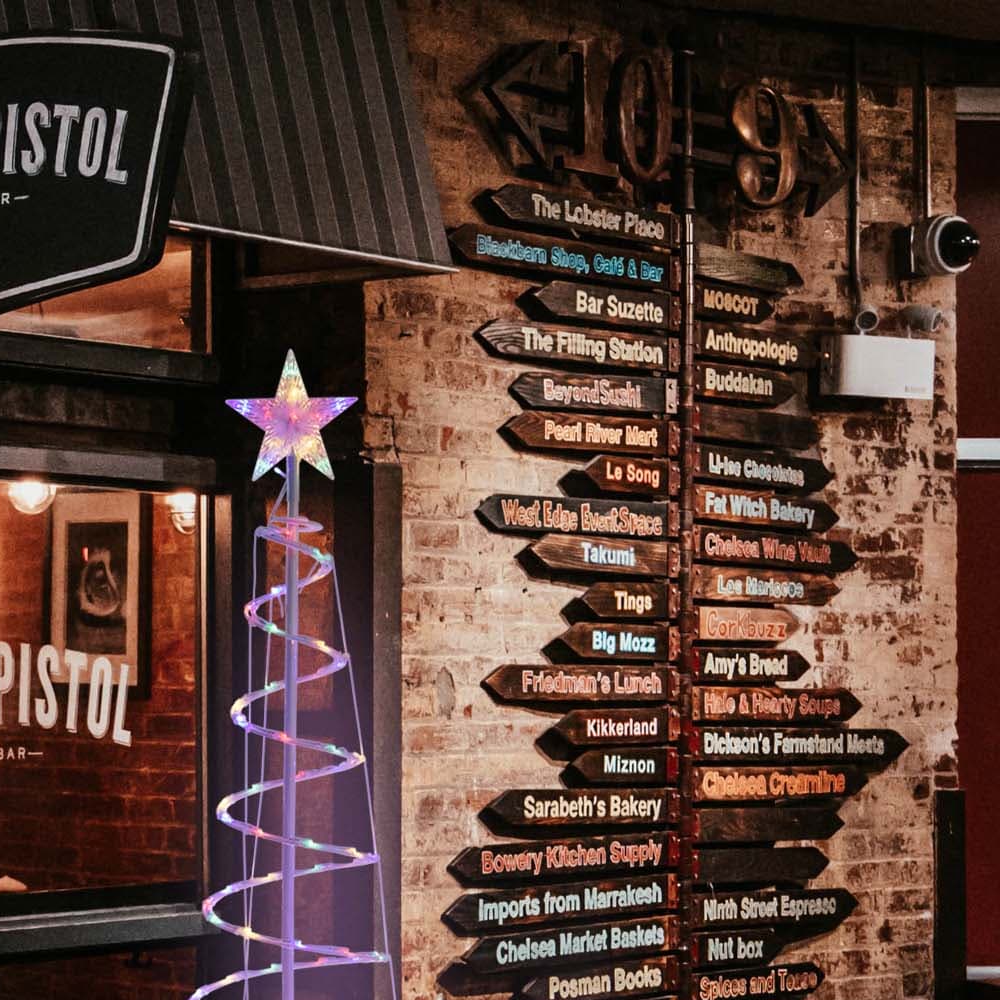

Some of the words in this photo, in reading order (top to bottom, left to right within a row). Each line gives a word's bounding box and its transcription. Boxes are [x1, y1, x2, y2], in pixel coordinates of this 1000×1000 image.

[732, 83, 797, 206] 9
[532, 193, 561, 220] The
[564, 199, 622, 232] Lobster
[624, 211, 665, 240] Place
[476, 233, 547, 265] Blackbarn
[551, 246, 590, 274] Shop,
[593, 253, 624, 278] Café
[626, 258, 638, 279] &
[640, 260, 664, 282] Bar
[576, 290, 604, 315] Bar
[607, 295, 665, 324] Suzette
[703, 288, 759, 316] MOSCOT
[521, 326, 553, 352] The
[557, 330, 606, 364] Filling
[609, 336, 664, 365] Station
[705, 328, 799, 366] Anthropologie
[705, 367, 773, 396] Buddakan
[544, 419, 582, 443] Pearl
[586, 423, 622, 446] River
[626, 425, 659, 447] Mart
[606, 461, 623, 481] Le
[626, 463, 660, 487] Song
[501, 499, 541, 529] West
[543, 500, 579, 532] Edge
[705, 491, 727, 515] Fat
[730, 494, 768, 519] Witch
[770, 498, 815, 529] Bakery
[580, 542, 636, 567] Takumi
[704, 532, 760, 559] Chelsea
[761, 537, 796, 562] Wine
[798, 541, 832, 564] Vault
[614, 590, 653, 614] Tings
[592, 630, 617, 655] Big
[619, 632, 656, 653] Mozz
[704, 651, 747, 680] Amy's
[750, 653, 788, 676] Bread
[522, 669, 611, 695] Friedman's
[614, 671, 662, 695] Lunch
[704, 692, 736, 715] Hale
[738, 693, 750, 715] &
[751, 693, 796, 719] Hearty
[799, 692, 841, 720] Soups
[587, 717, 658, 737] Kikkerland
[703, 732, 770, 756] Dickson's
[773, 731, 844, 755] Farmstand
[846, 733, 885, 756] Meats
[603, 755, 656, 773] Miznon
[702, 770, 767, 799] Chelsea
[769, 769, 846, 796] Creamline
[523, 794, 606, 819] Sarabeth's
[610, 795, 662, 821] Bakery
[481, 850, 543, 876] Bowery
[546, 844, 606, 869] Kitchen
[609, 839, 662, 868] Supply
[478, 895, 541, 925] Imports
[544, 891, 581, 914] from
[584, 882, 663, 910] Marrakesh
[703, 898, 738, 921] Ninth
[740, 896, 779, 920] Street
[780, 895, 837, 921] Espresso
[496, 937, 556, 965] Chelsea
[559, 930, 608, 956] Market
[610, 924, 665, 949] Baskets
[707, 937, 735, 961] Nut
[736, 936, 764, 960] box
[549, 975, 611, 1000] Posman
[614, 965, 662, 991] Books
[750, 969, 775, 998] and
